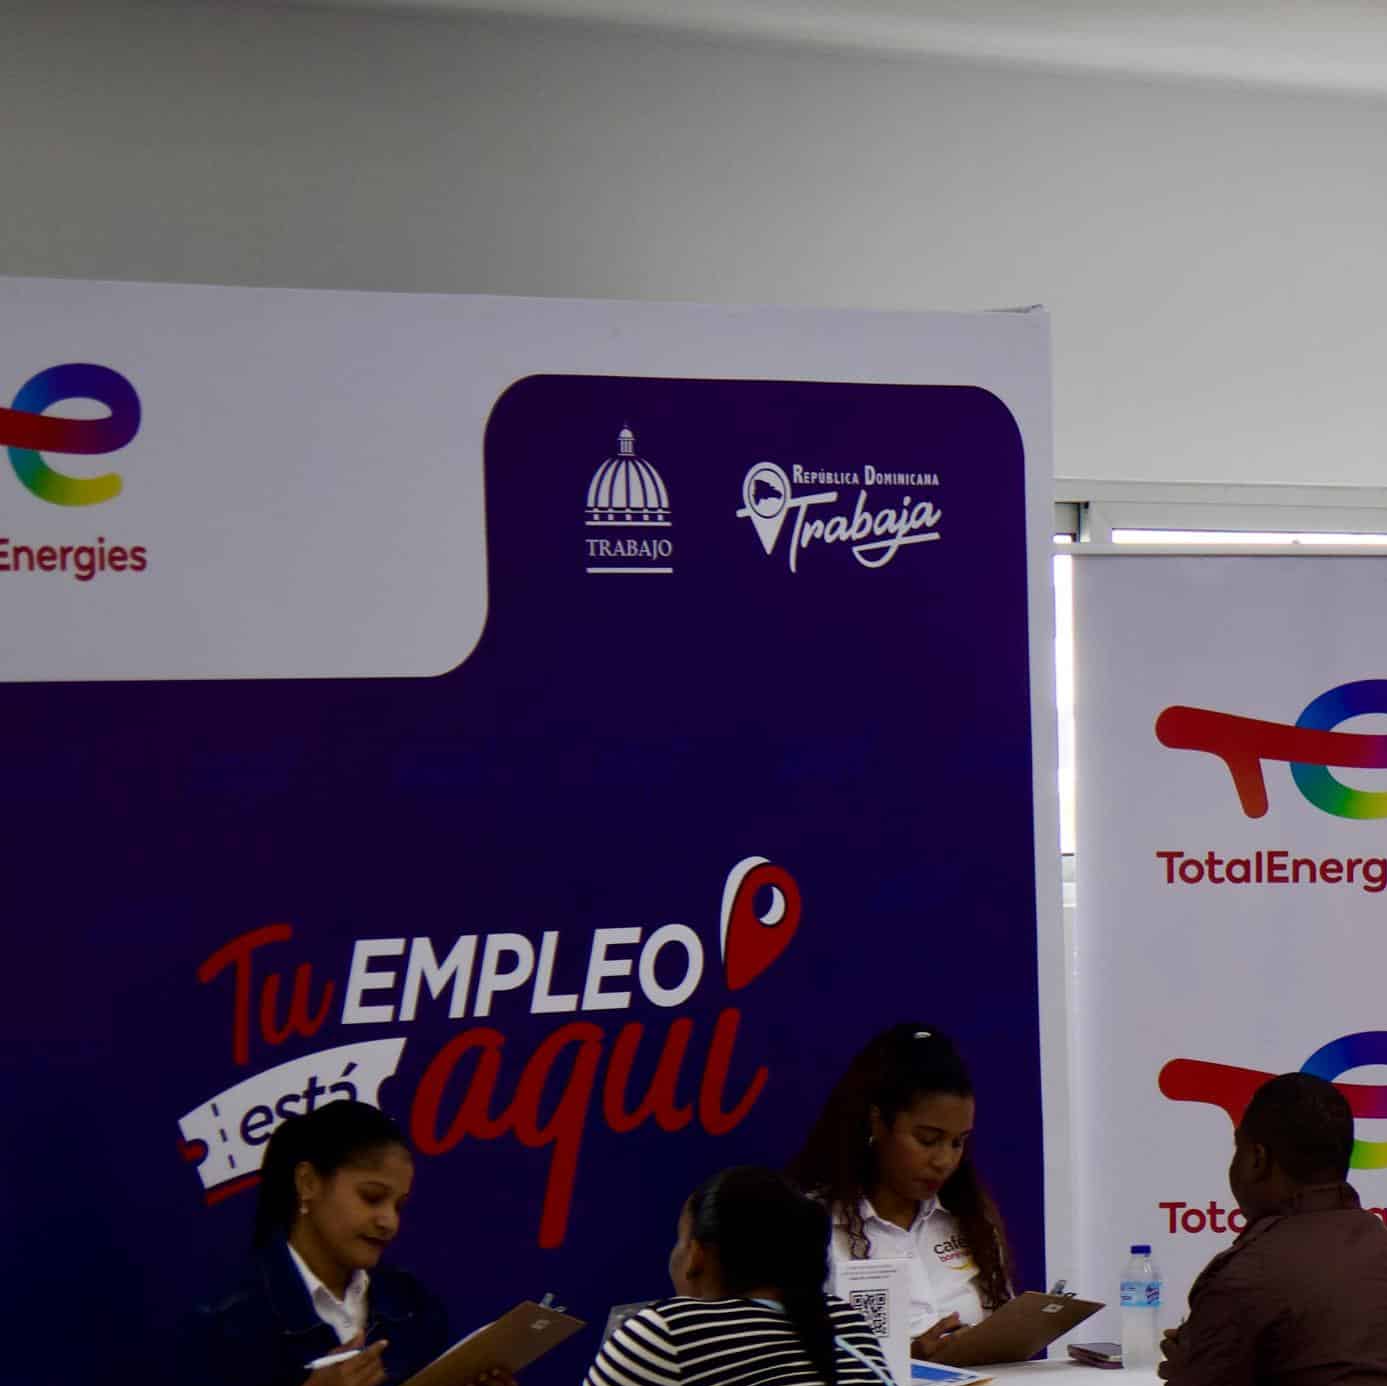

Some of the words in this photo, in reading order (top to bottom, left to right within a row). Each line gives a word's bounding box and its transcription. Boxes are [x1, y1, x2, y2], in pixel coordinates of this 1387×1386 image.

[865, 465, 940, 486] DOMINICANA
[585, 539, 673, 560] TRABAJO
[787, 489, 943, 574] Trabaja
[197, 923, 334, 1067] Tu
[342, 923, 705, 1025] EMPLEO
